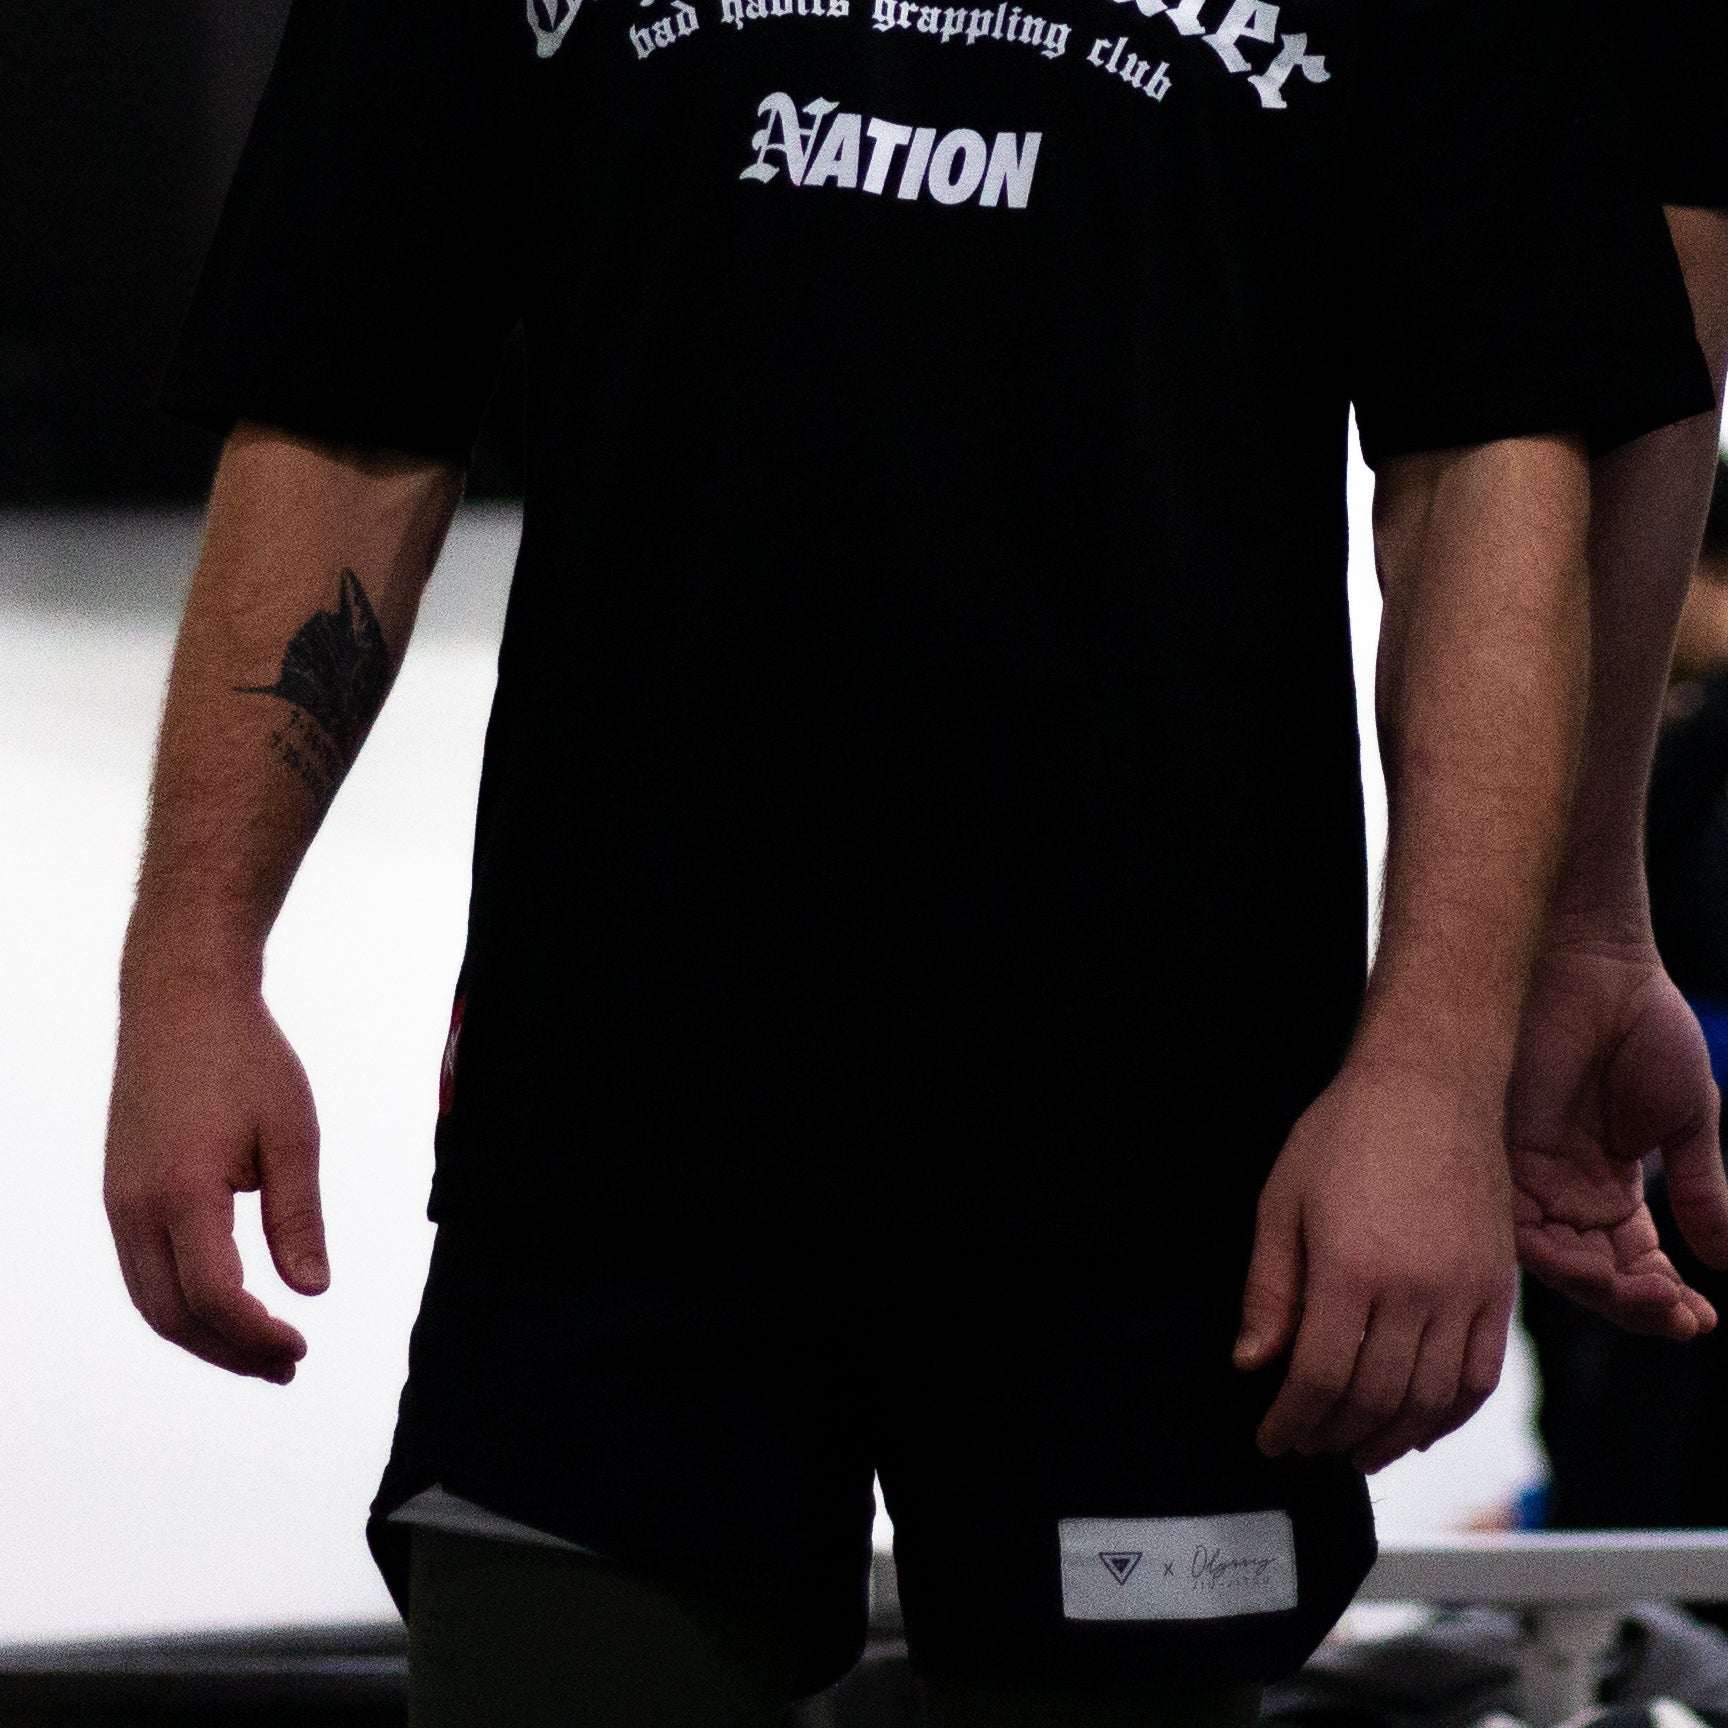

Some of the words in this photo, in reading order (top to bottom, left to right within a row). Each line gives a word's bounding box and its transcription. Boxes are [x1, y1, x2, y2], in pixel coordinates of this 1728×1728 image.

[629, 0, 700, 60] bad
[1086, 36, 1173, 103] club
[739, 91, 1043, 209] NATION
